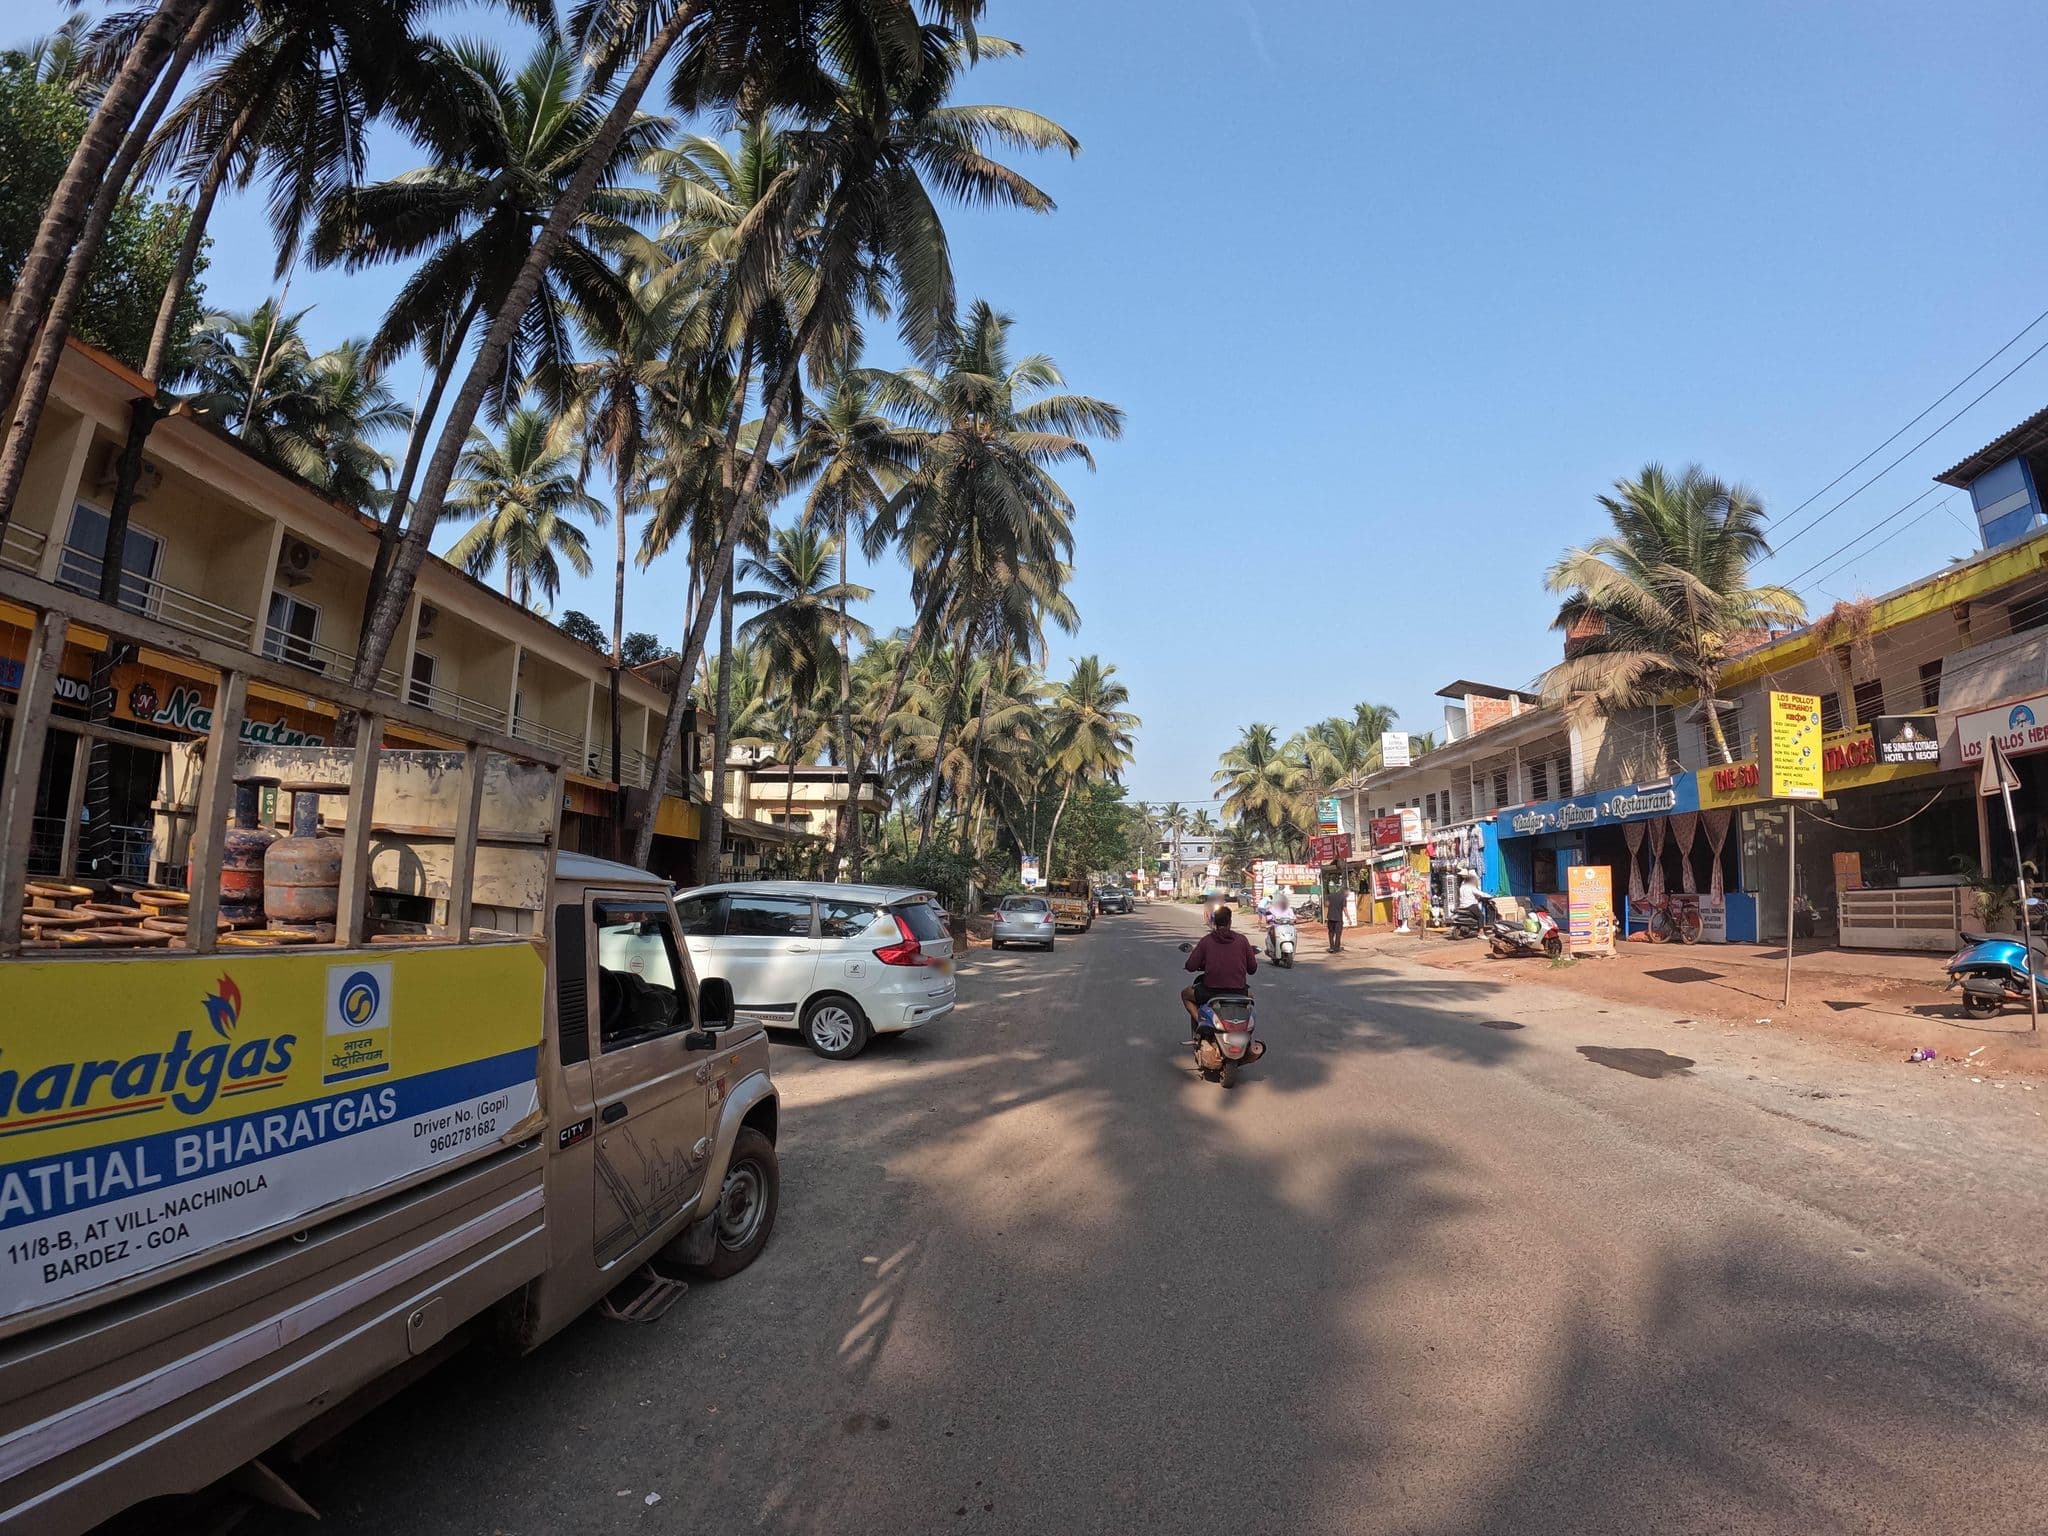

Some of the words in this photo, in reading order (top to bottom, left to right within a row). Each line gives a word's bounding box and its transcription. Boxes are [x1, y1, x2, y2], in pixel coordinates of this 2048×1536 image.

[1883, 742, 1893, 753] THE
[1884, 753, 1905, 762] HOTEL
[1916, 751, 1938, 760] RESORT
[1963, 740, 1982, 758] LOS
[1999, 731, 2024, 751] LLOS
[1713, 770, 1737, 792] THE
[1557, 804, 1597, 830] Aflatoon
[1611, 790, 1676, 818] Restaurant
[344, 1038, 373, 1051] भारत
[332, 1049, 384, 1069] पेट्रोलियम
[413, 1116, 452, 1138] Driver
[455, 1108, 473, 1125] No.
[477, 1095, 509, 1120] (Gopi)
[174, 1087, 398, 1178] BHARATGAS
[430, 1118, 496, 1153] 9602781682
[561, 1122, 585, 1141] CITY
[7, 1228, 79, 1265] 11/8-B,
[84, 1219, 109, 1245] AT
[115, 1174, 268, 1233] VILL-NACHINOLA
[43, 1239, 130, 1284] BARDEZ
[147, 1222, 190, 1249] GOA
